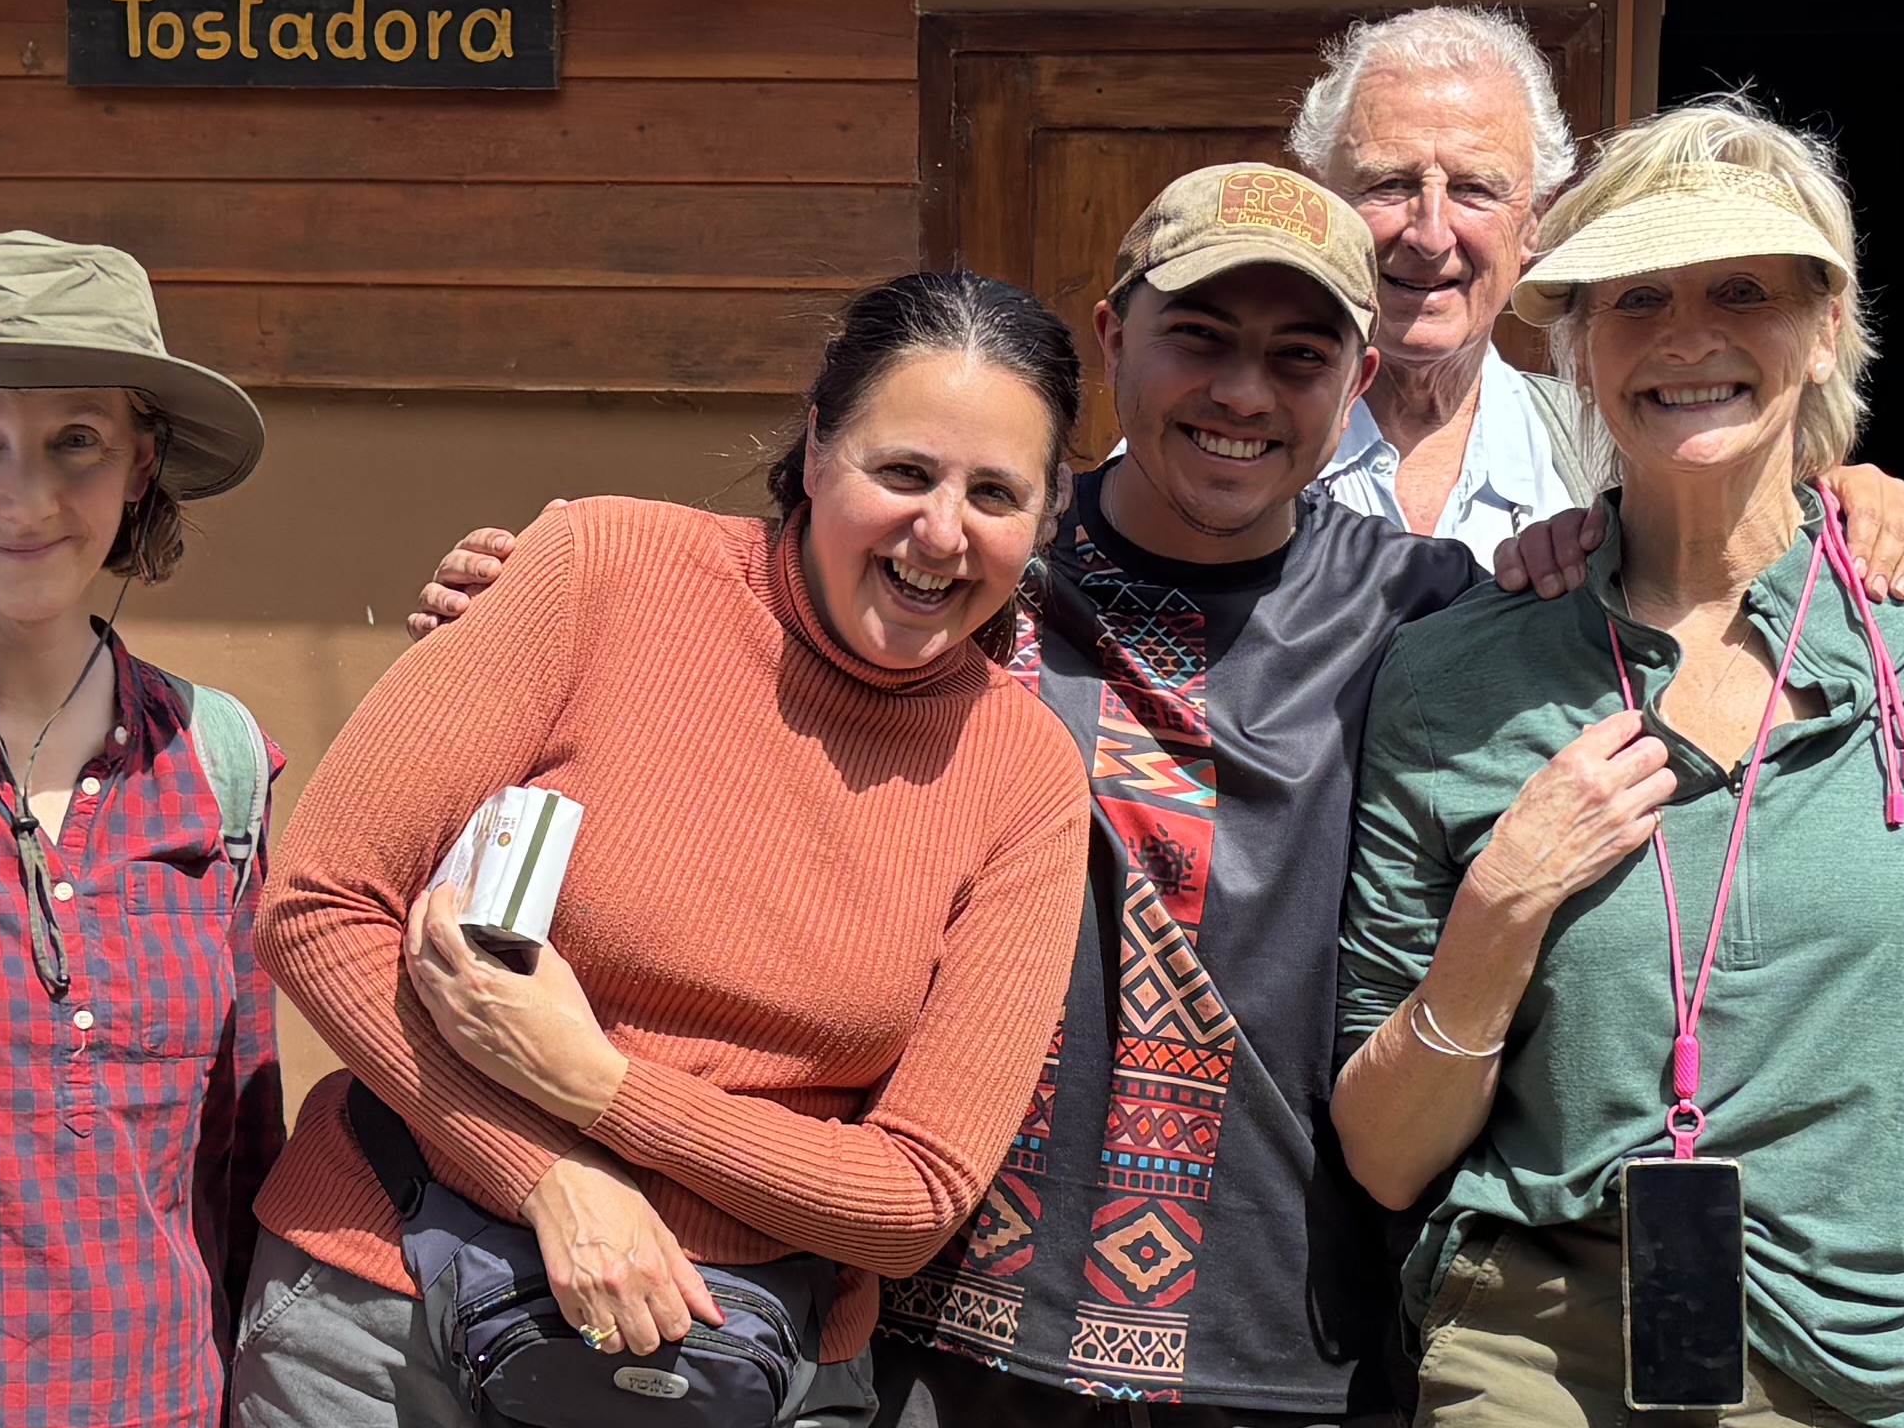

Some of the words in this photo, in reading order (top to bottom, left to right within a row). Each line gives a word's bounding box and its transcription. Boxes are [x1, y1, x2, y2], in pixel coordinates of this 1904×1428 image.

[1228, 174, 1324, 212] COSTA
[1244, 188, 1308, 222] RICA
[1236, 211, 1273, 226] Pura
[1276, 218, 1312, 242] Vida
